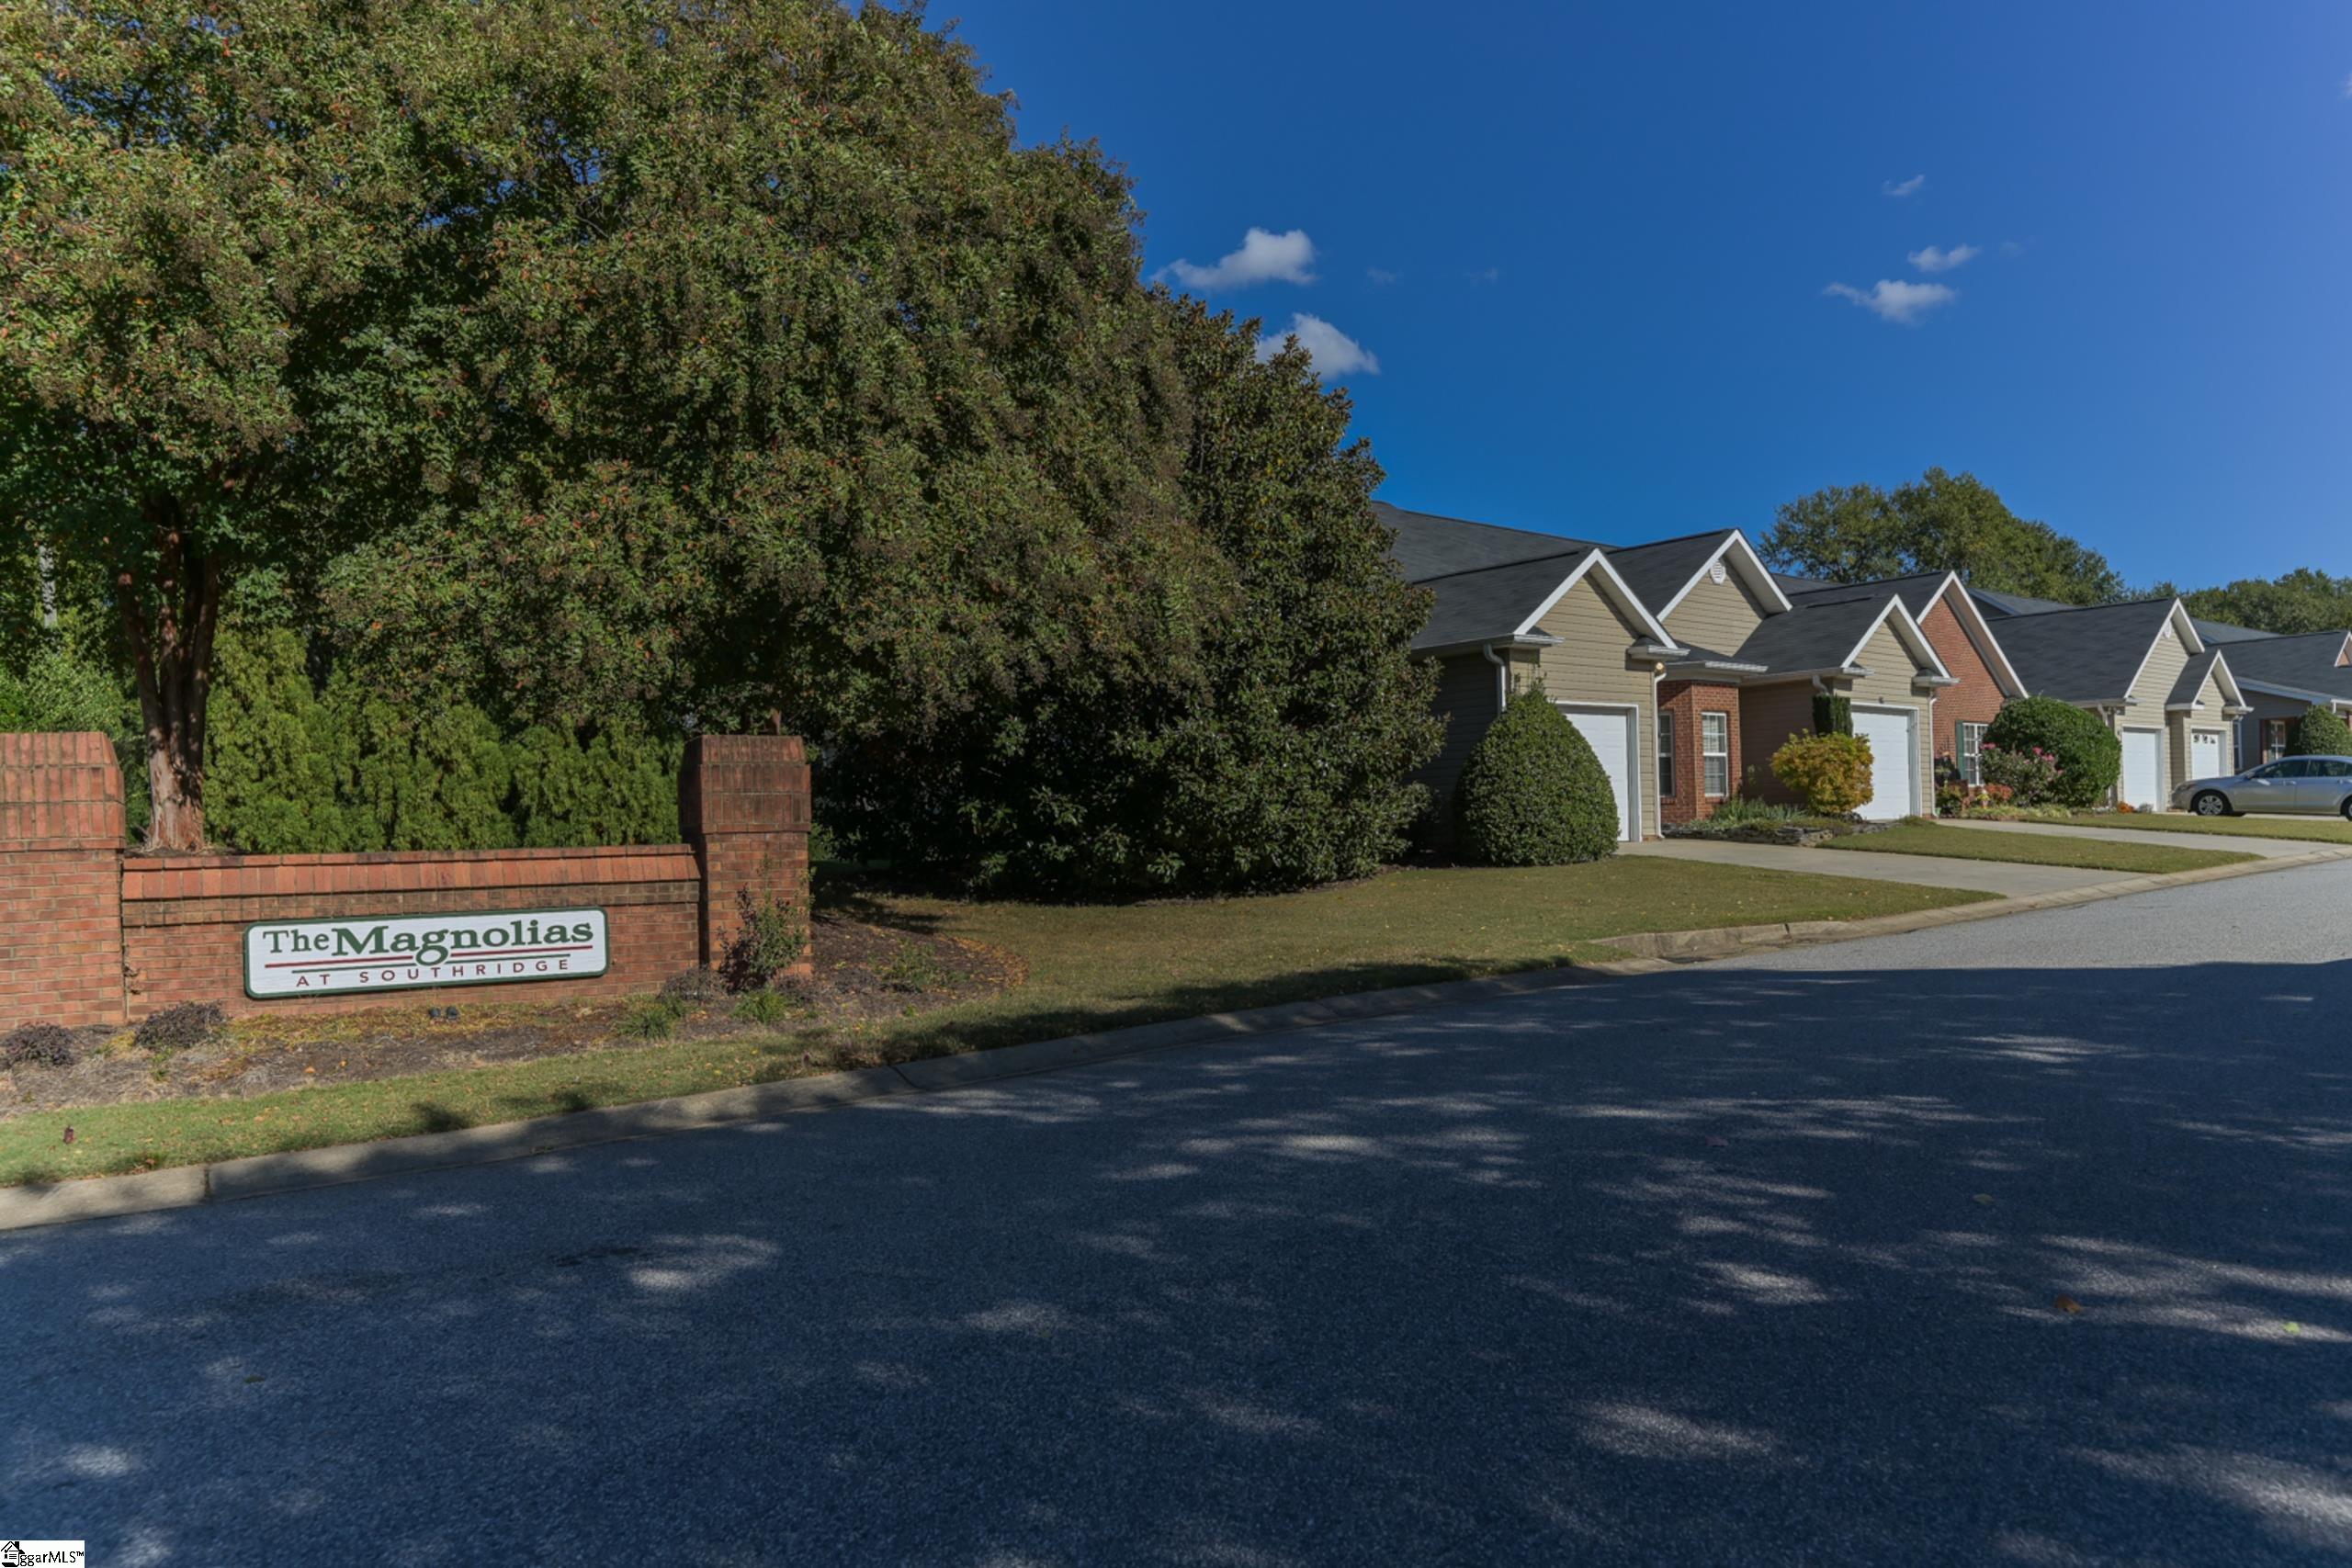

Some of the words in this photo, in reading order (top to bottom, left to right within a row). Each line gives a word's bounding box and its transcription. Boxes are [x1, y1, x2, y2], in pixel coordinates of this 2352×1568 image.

[263, 929, 329, 953] The
[332, 919, 594, 966] Magnolias
[296, 974, 332, 987] AT
[359, 959, 570, 983] SOUTHRIDGE
